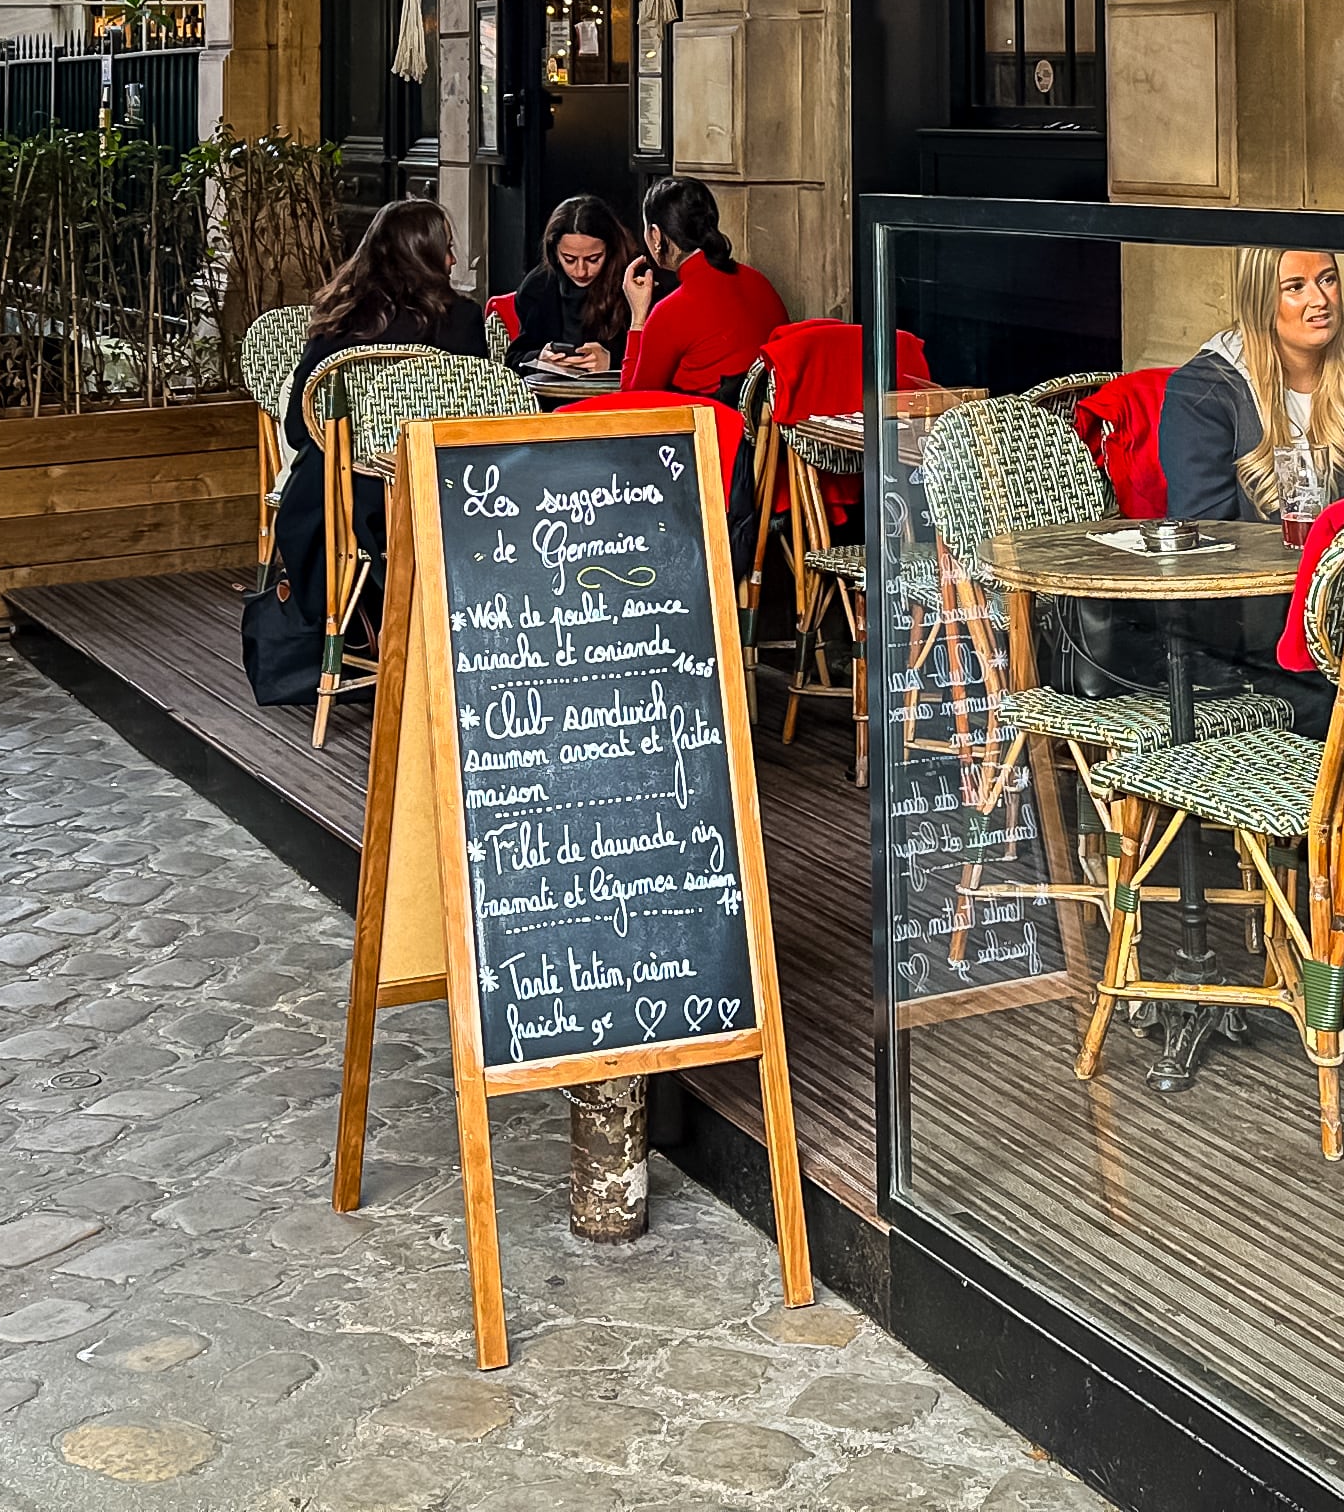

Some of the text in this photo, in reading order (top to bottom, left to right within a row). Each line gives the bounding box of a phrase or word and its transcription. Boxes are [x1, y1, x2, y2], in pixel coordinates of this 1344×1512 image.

[462, 464, 664, 526] Les suggestions
[493, 518, 650, 596] de Germaine
[519, 593, 546, 629] de
[549, 591, 619, 647] poulet,
[621, 599, 690, 619] sauce
[457, 632, 550, 673] sriracha
[555, 632, 578, 667] et
[485, 679, 668, 740] Club sandwich
[463, 704, 723, 810] saumon avocat et frites
[465, 783, 550, 810] maison
[483, 811, 725, 876] Filet de daurade, riz
[474, 865, 737, 939] basmati et légumes saison
[499, 952, 564, 1001] Tarte
[632, 951, 698, 982] crème
[506, 997, 585, 1063] fraiche
